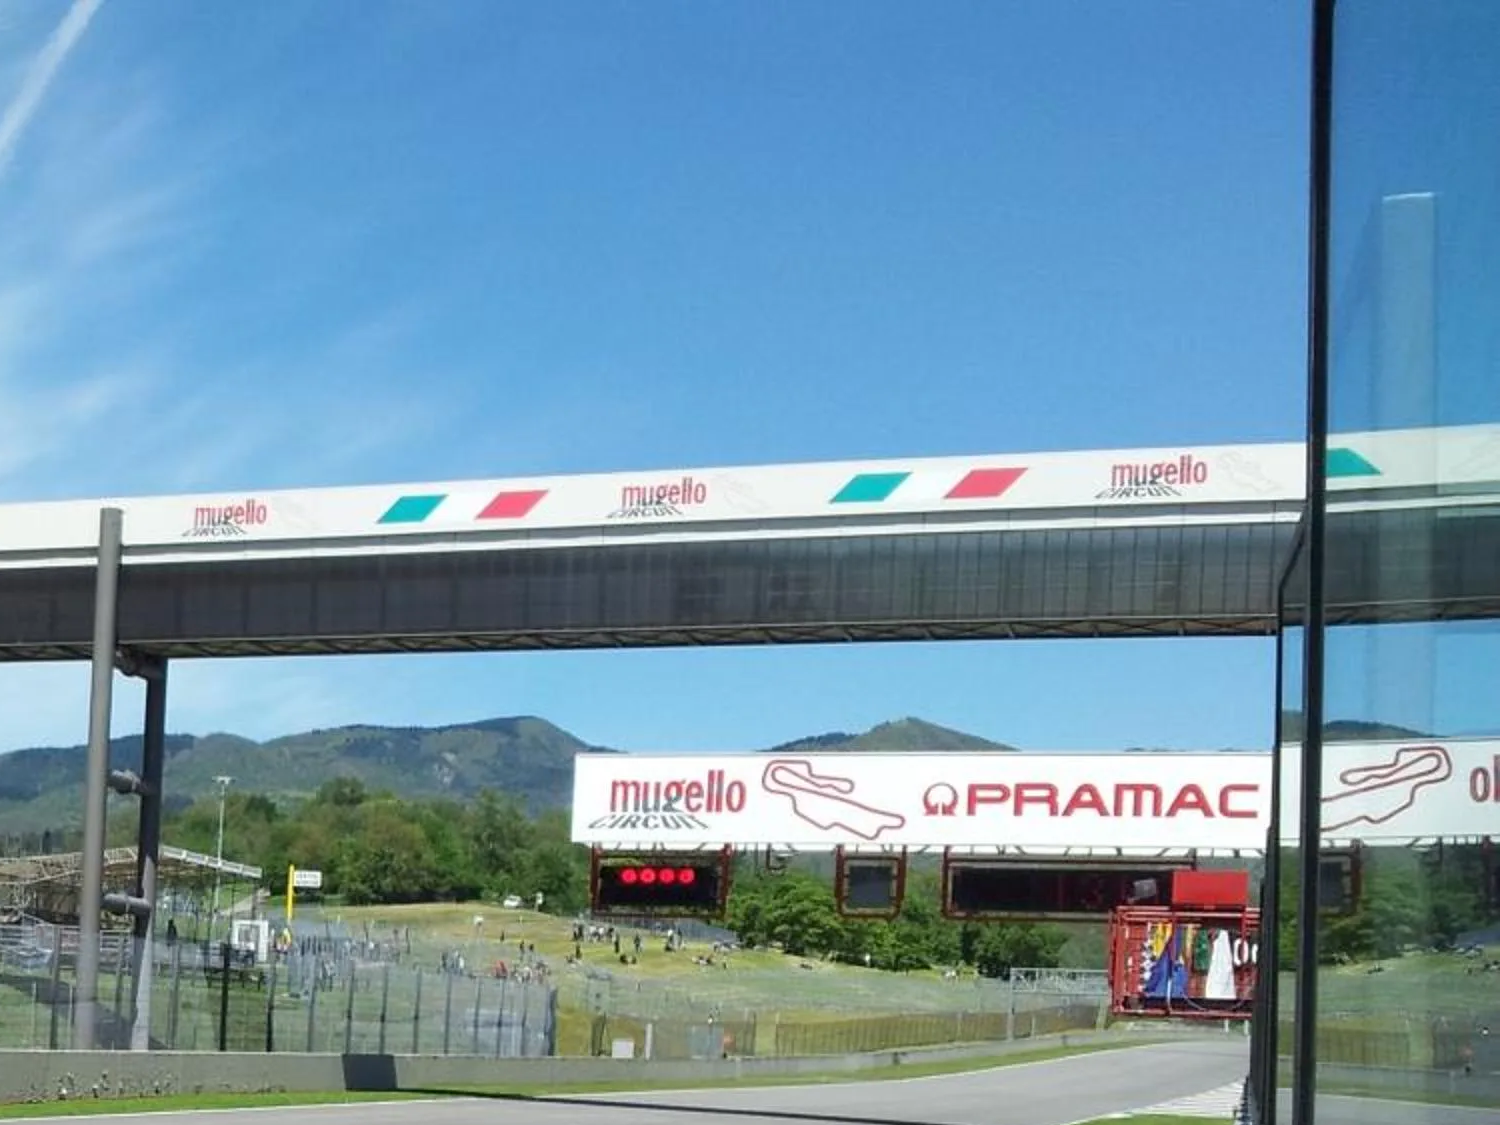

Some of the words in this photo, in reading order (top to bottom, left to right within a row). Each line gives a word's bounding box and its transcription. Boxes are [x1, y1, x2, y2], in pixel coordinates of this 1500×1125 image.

[1110, 453, 1208, 487] mugello
[621, 475, 707, 508] mugello
[193, 497, 268, 529] mugello
[609, 769, 747, 813] mugello
[966, 782, 1261, 819] PRAMAC
[587, 813, 710, 830] CIRCUIT
